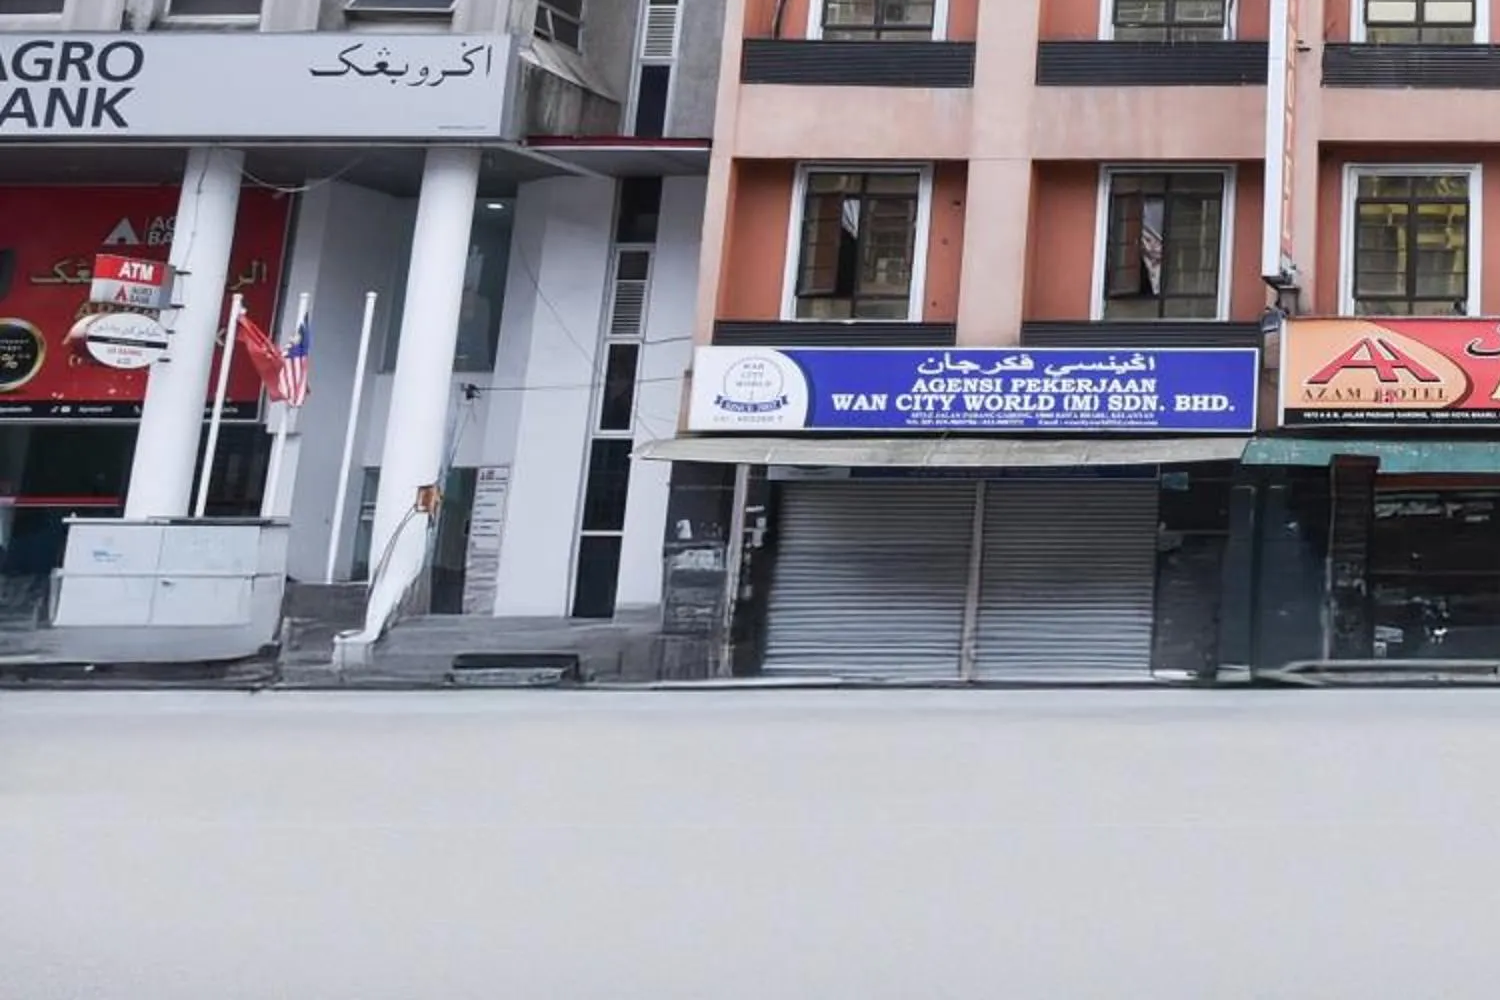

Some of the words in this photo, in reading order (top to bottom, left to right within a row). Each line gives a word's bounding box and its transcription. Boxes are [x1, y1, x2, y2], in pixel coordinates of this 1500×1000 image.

[0, 87, 135, 128] ANK
[118, 261, 154, 281] ATM
[911, 378, 1003, 393] AGENSI
[1010, 377, 1157, 393] PEKERJAAN
[832, 393, 888, 411] WAN
[895, 393, 957, 411] CITY
[963, 393, 1055, 411] WORLD
[1063, 393, 1099, 412] (M)
[1107, 393, 1165, 411] SDN.
[1174, 393, 1236, 411] BHD.
[1304, 387, 1361, 400] AZAM
[1374, 387, 1449, 403] HOTEL
